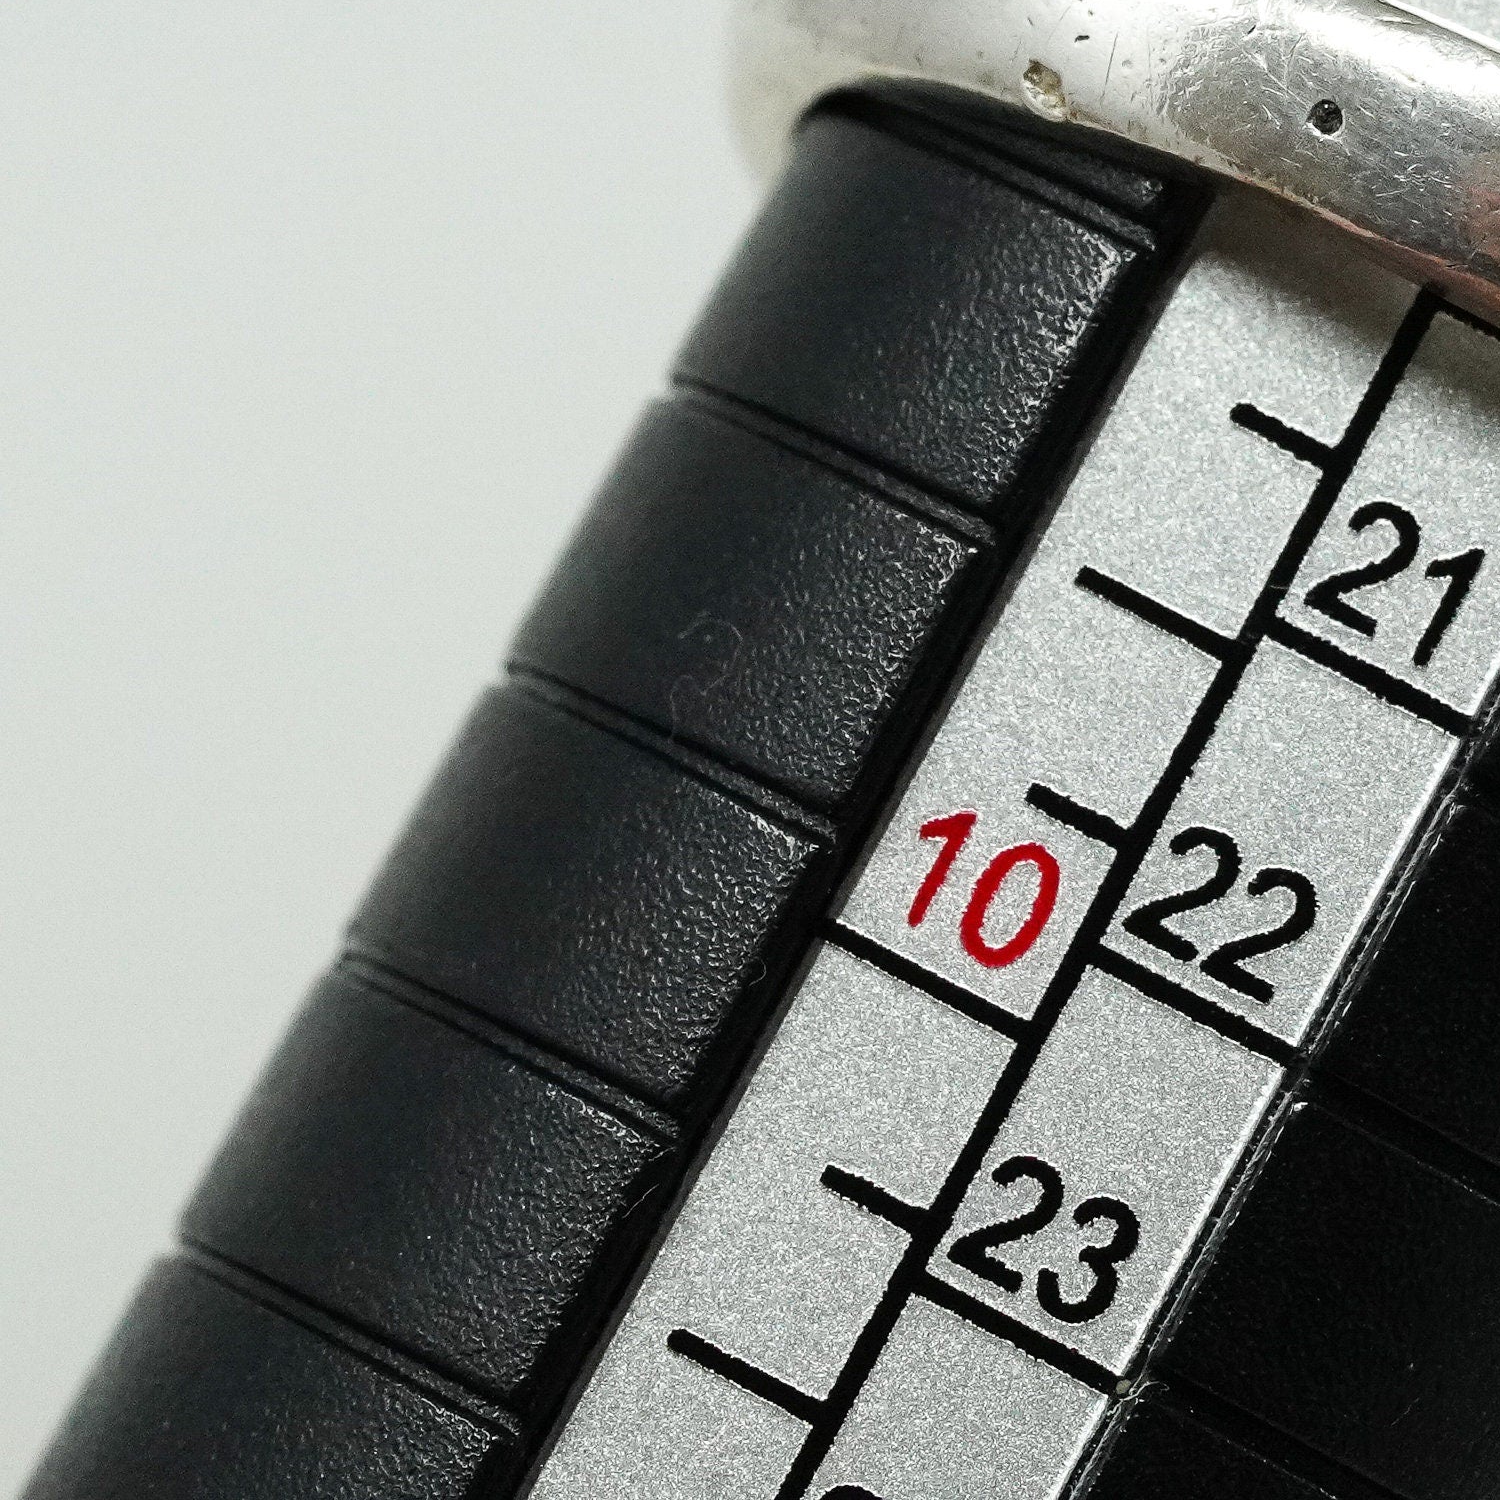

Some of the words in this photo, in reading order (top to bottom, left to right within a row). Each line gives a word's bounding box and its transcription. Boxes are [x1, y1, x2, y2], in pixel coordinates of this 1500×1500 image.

[1302, 501, 1487, 671] 21
[907, 812, 1061, 971] 10
[1121, 826, 1321, 1007] 22
[945, 1155, 1142, 1327] 23
